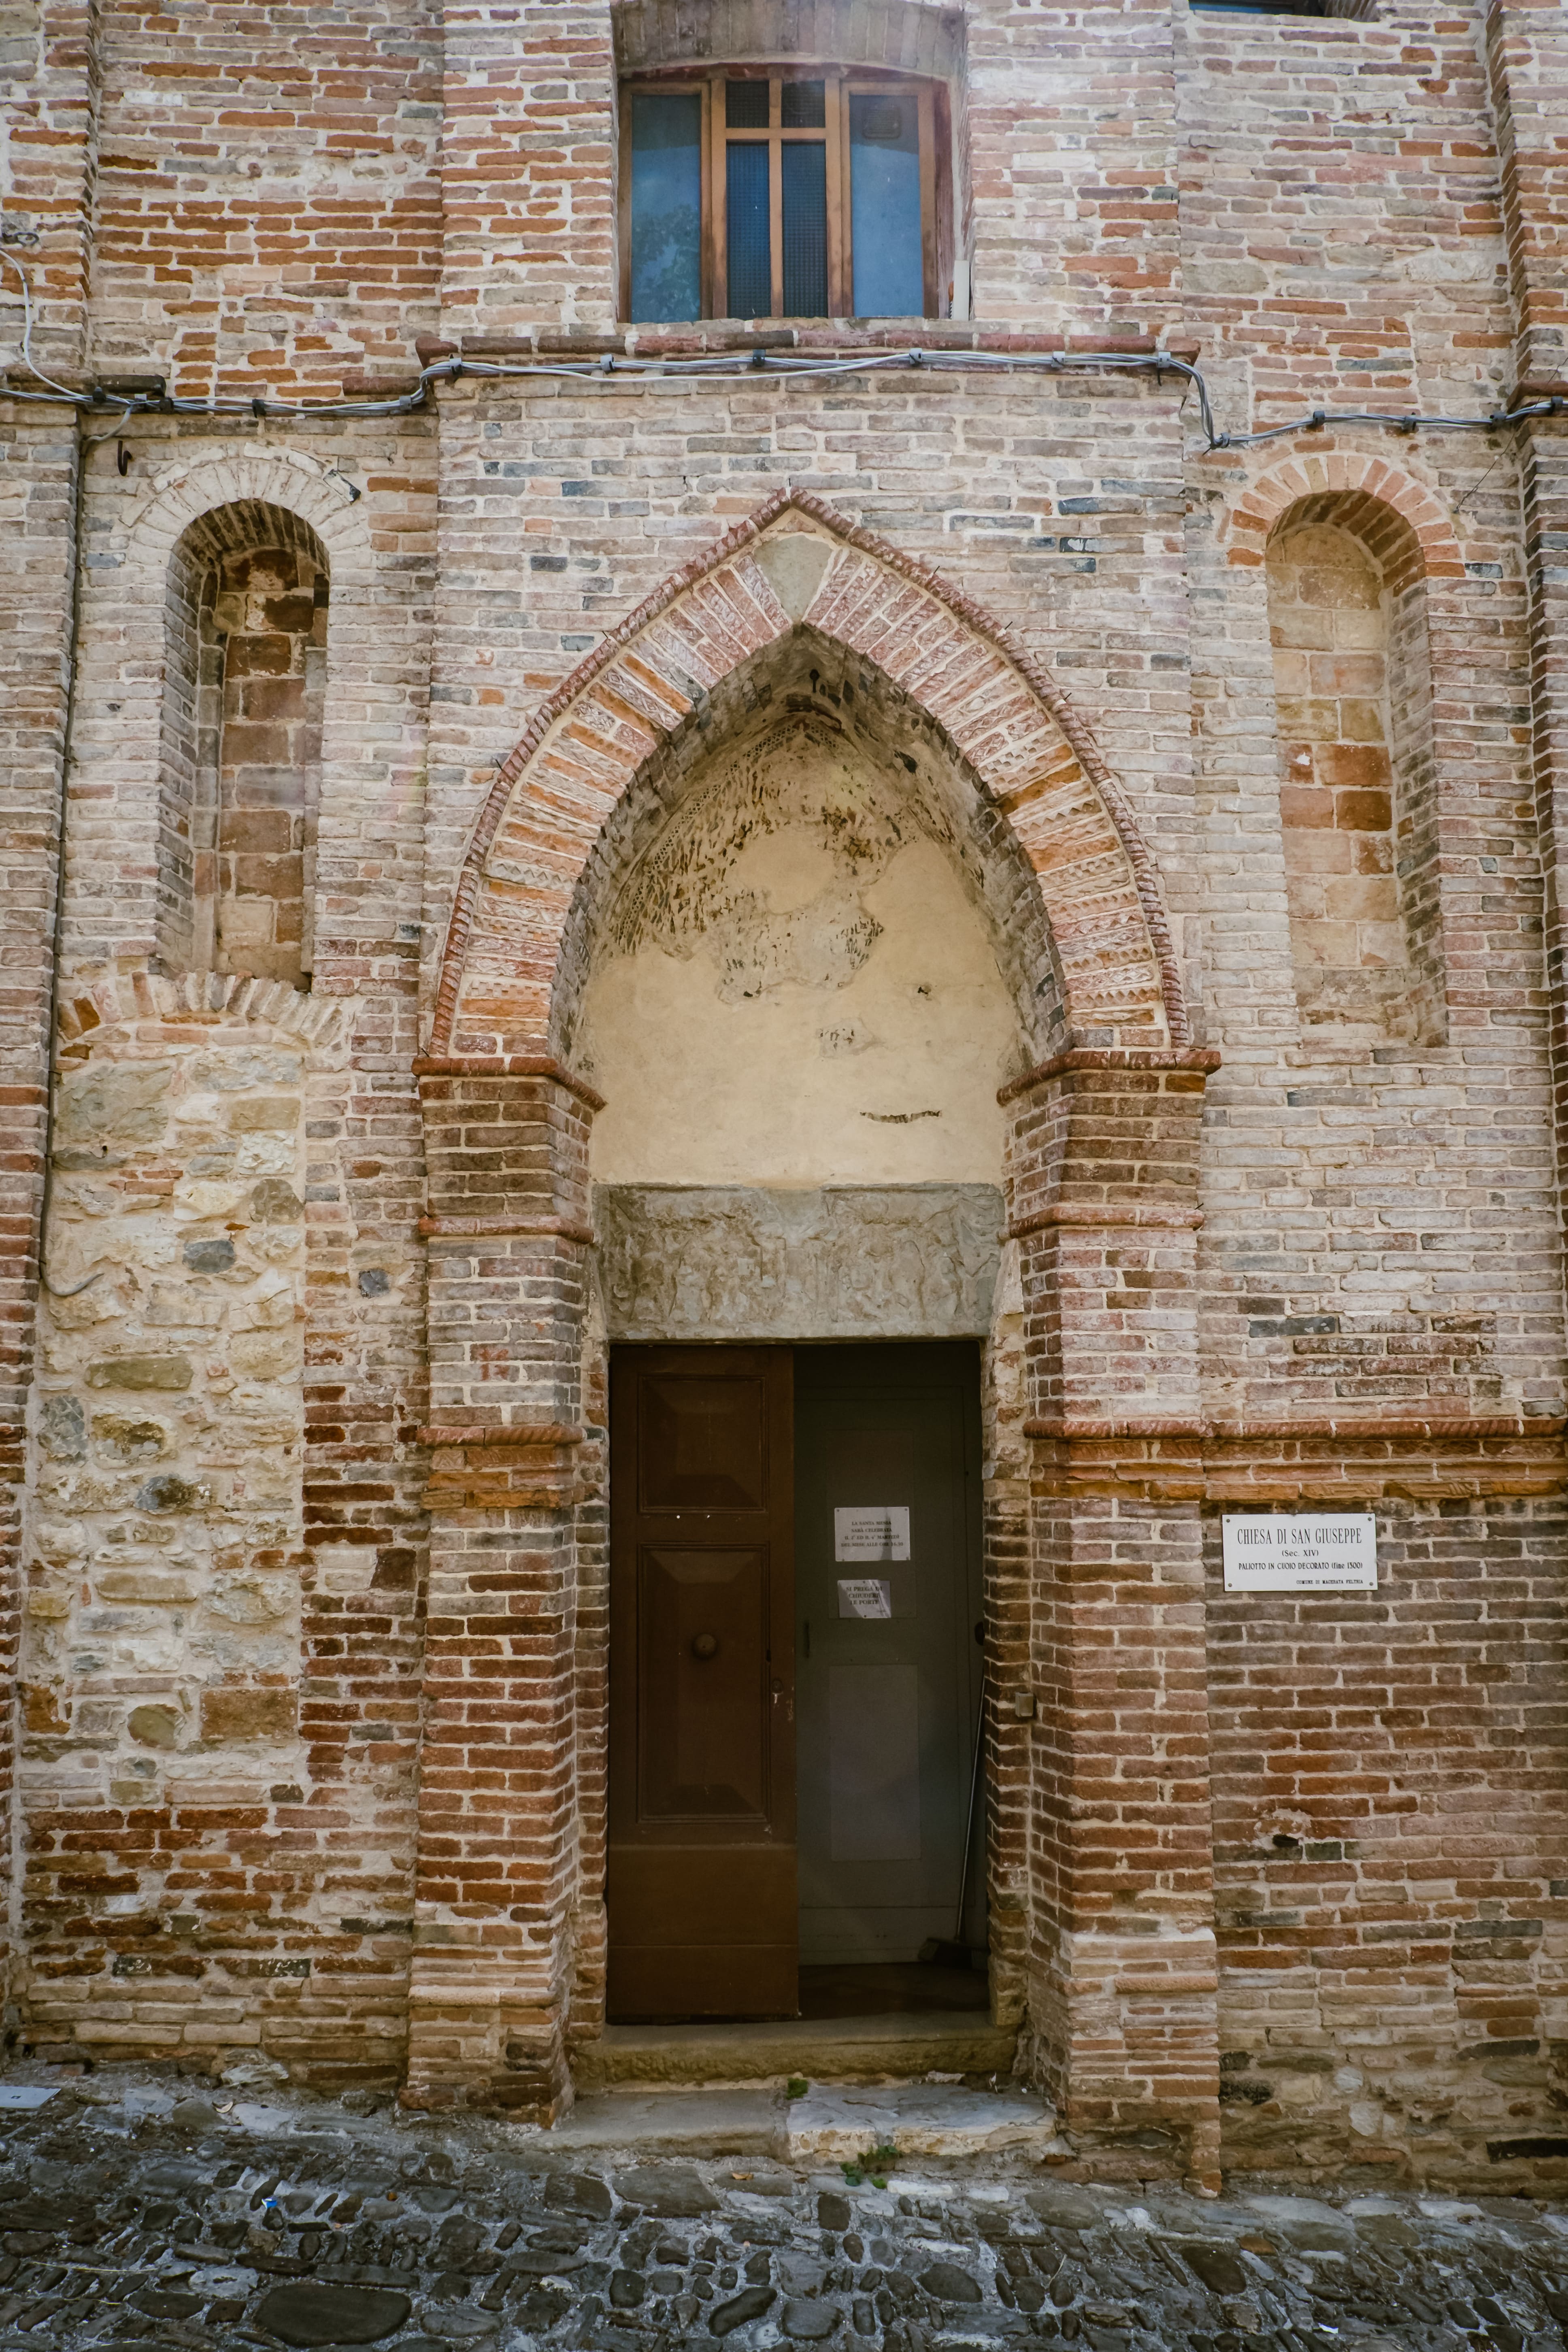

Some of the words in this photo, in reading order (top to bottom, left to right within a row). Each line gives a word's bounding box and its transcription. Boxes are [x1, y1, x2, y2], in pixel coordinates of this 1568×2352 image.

[1238, 1529, 1272, 1544] CHIESA
[1277, 1529, 1286, 1544] DI
[1292, 1529, 1310, 1544] SAN
[1316, 1528, 1362, 1543] GIUSEPPE
